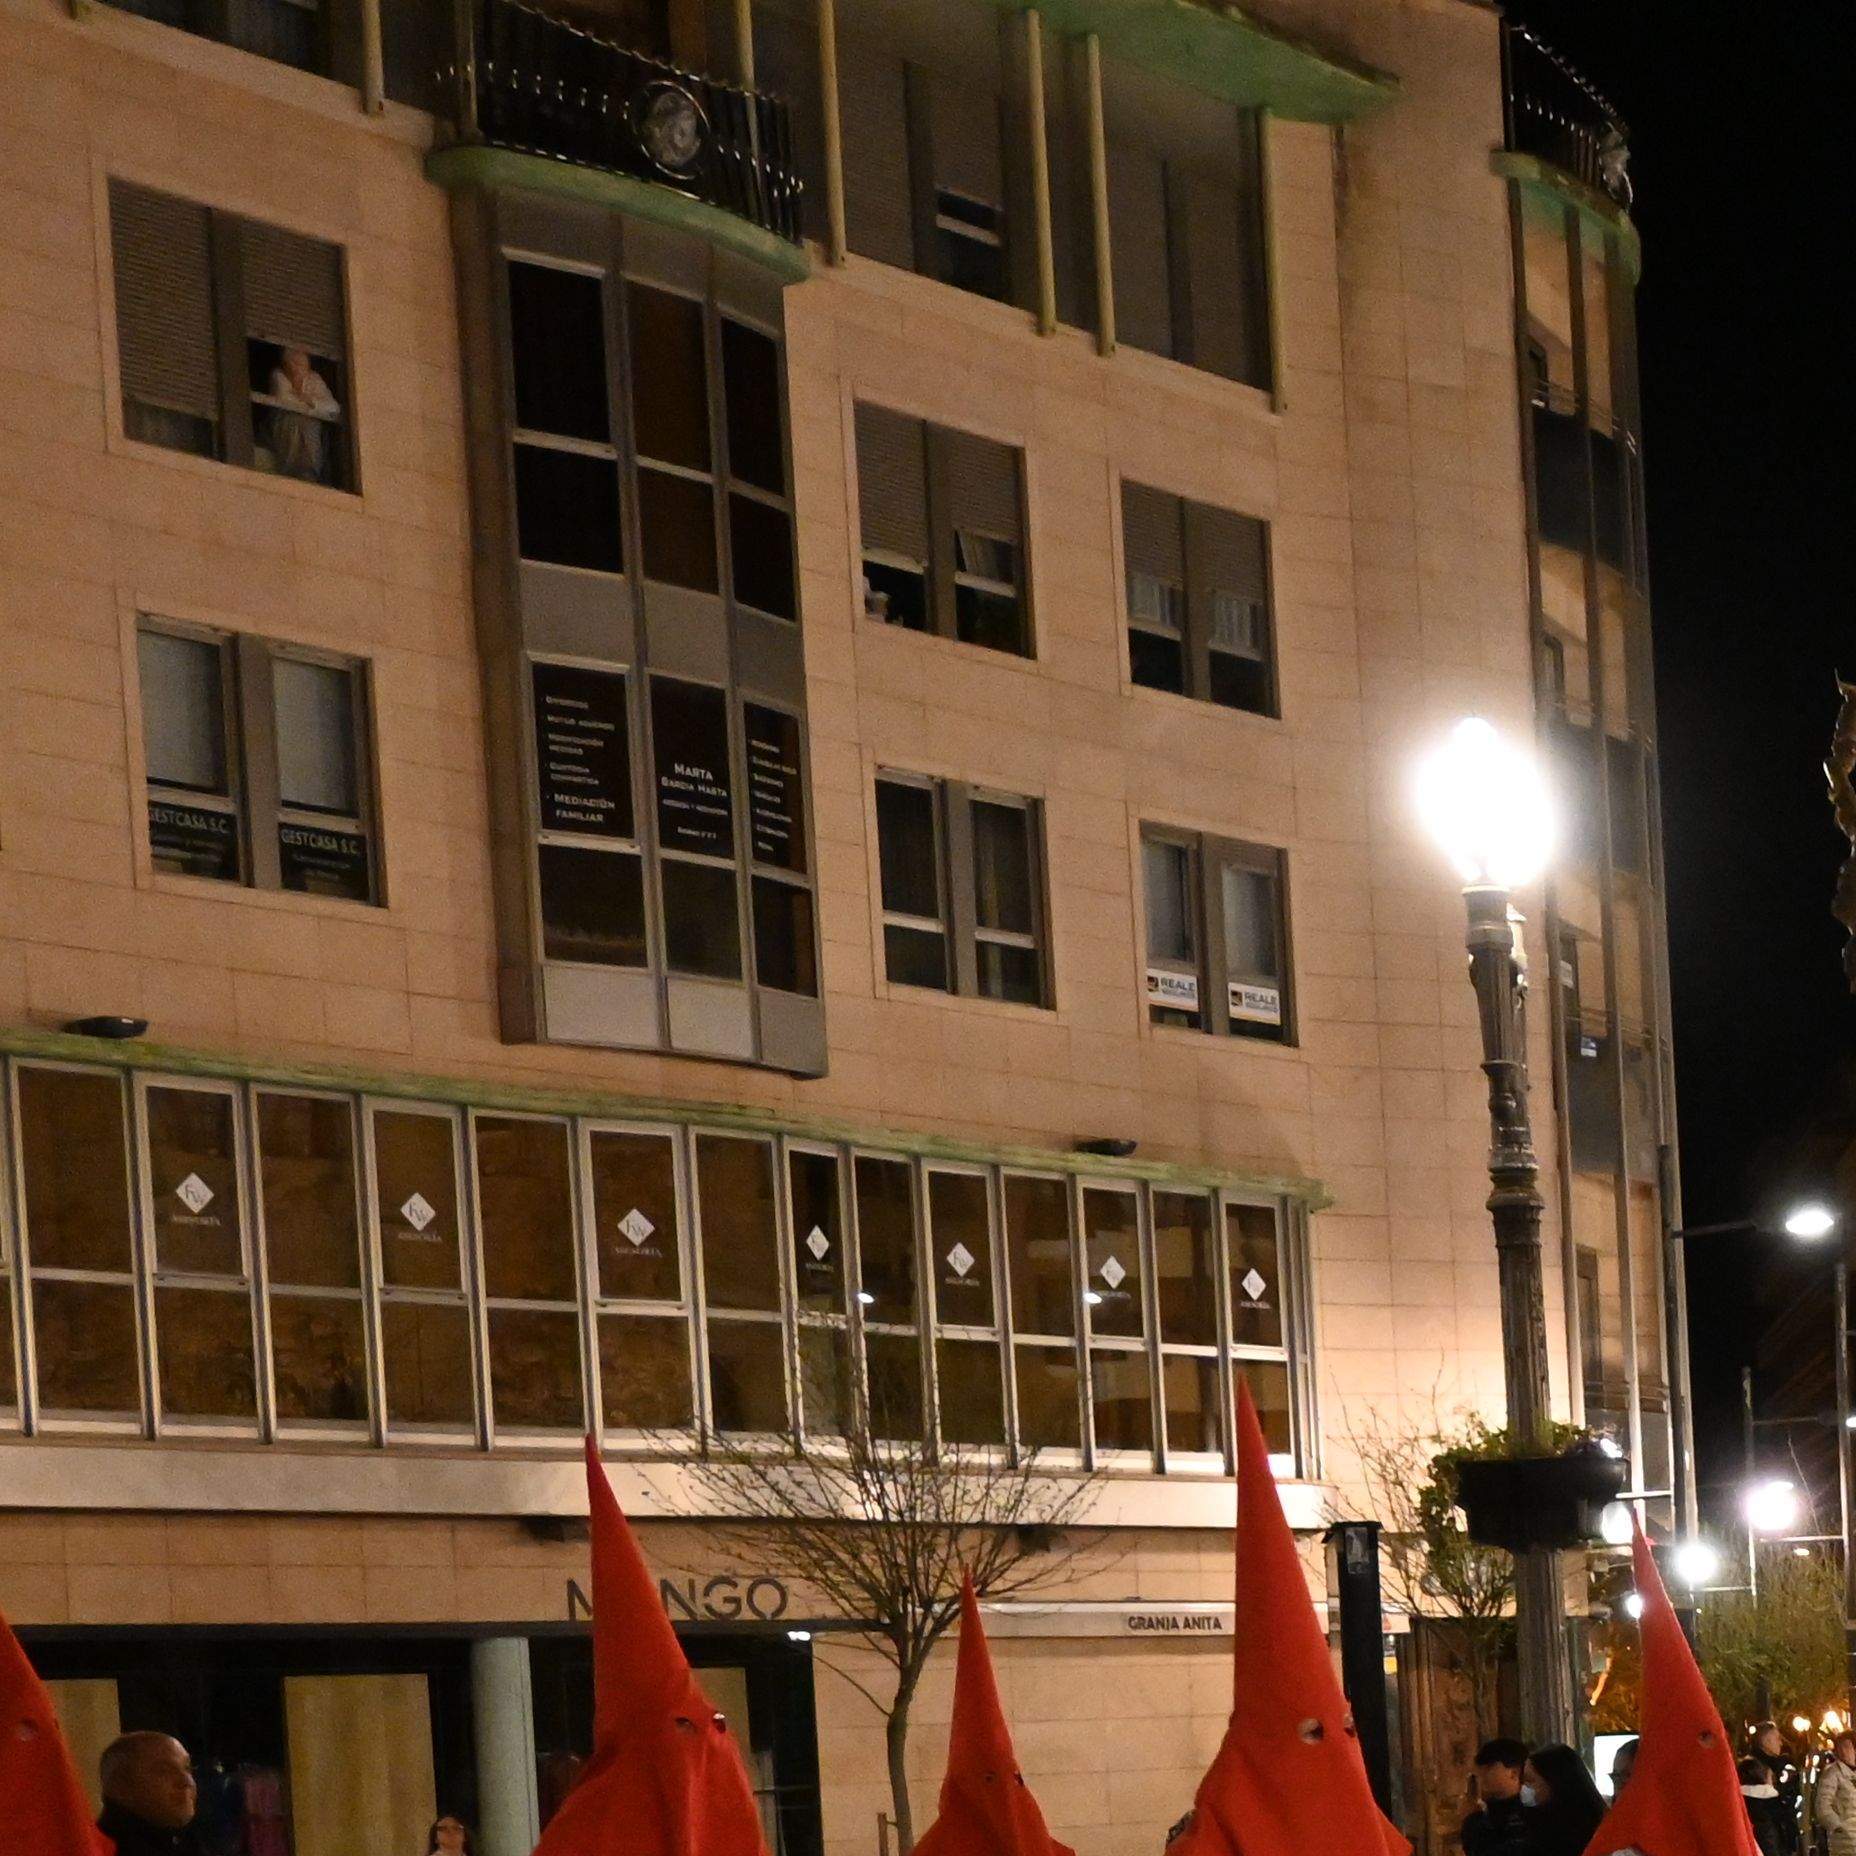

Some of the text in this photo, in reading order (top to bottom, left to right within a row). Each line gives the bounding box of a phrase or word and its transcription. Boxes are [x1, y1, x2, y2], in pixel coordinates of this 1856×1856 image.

[555, 809, 604, 823] FAMILIAR
[1161, 977, 1195, 991] REALE
[566, 1575, 788, 1622] MNGO
[1128, 1616, 1223, 1631] GRANJA ANITA
